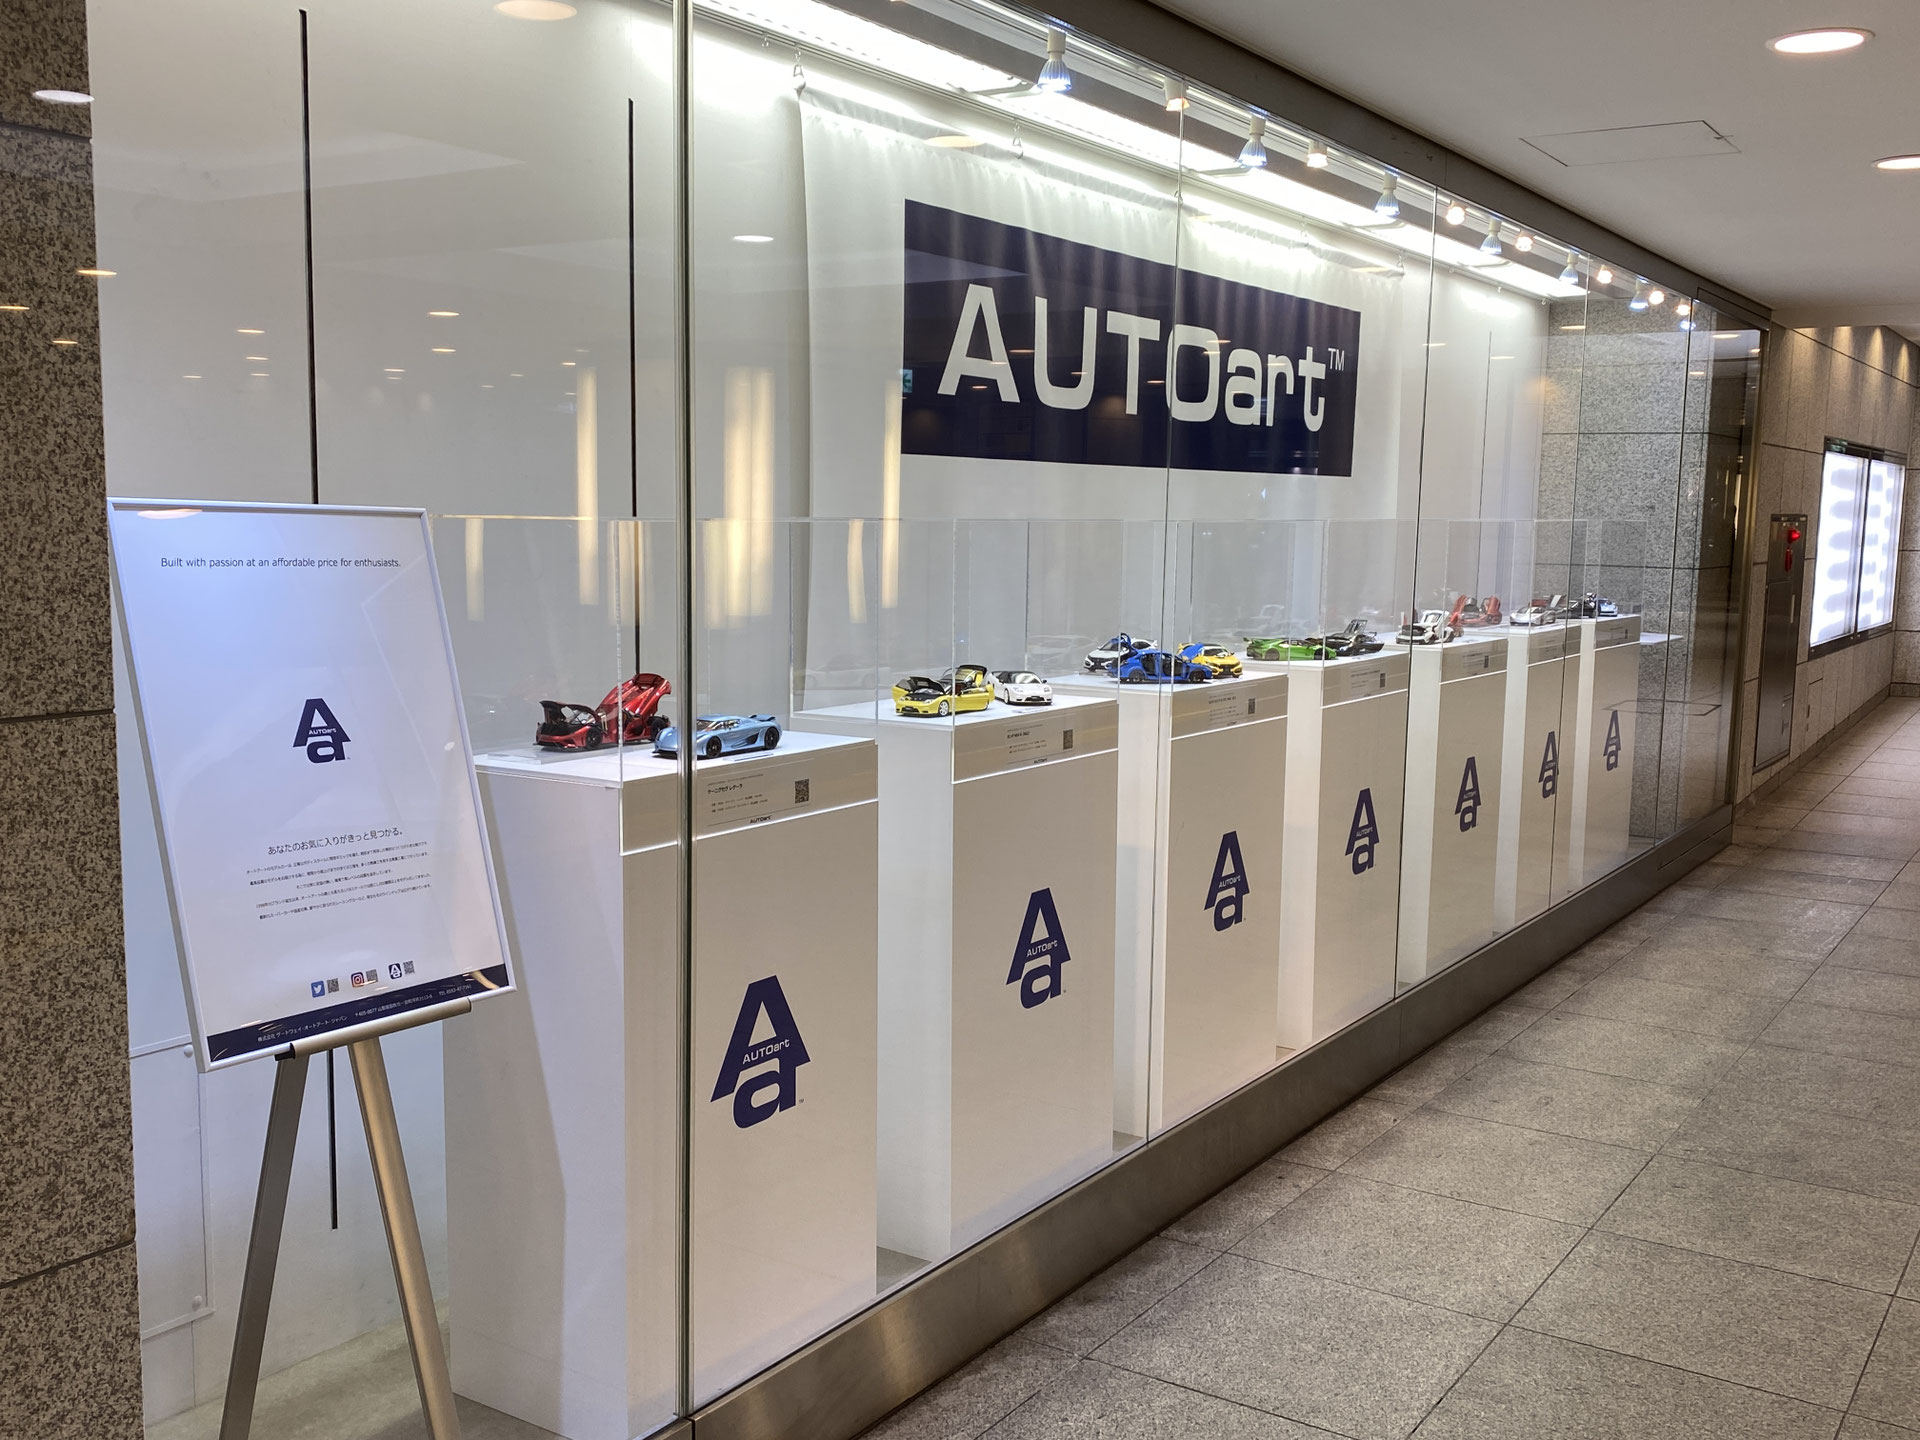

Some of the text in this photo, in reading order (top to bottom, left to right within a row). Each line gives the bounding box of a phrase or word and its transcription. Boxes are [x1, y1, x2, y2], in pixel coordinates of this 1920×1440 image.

[938, 284, 1326, 432] AUTOart
[161, 558, 182, 567] Built
[186, 558, 206, 567] with
[209, 559, 243, 568] passion
[246, 559, 255, 567] at
[272, 558, 315, 567] affordable
[318, 559, 338, 568] price
[341, 558, 352, 567] for
[354, 559, 401, 567] enthusiasts.
[268, 827, 403, 855] あなたのお気に入りがきっと見つかる。
[742, 1039, 791, 1064] AUTOart
